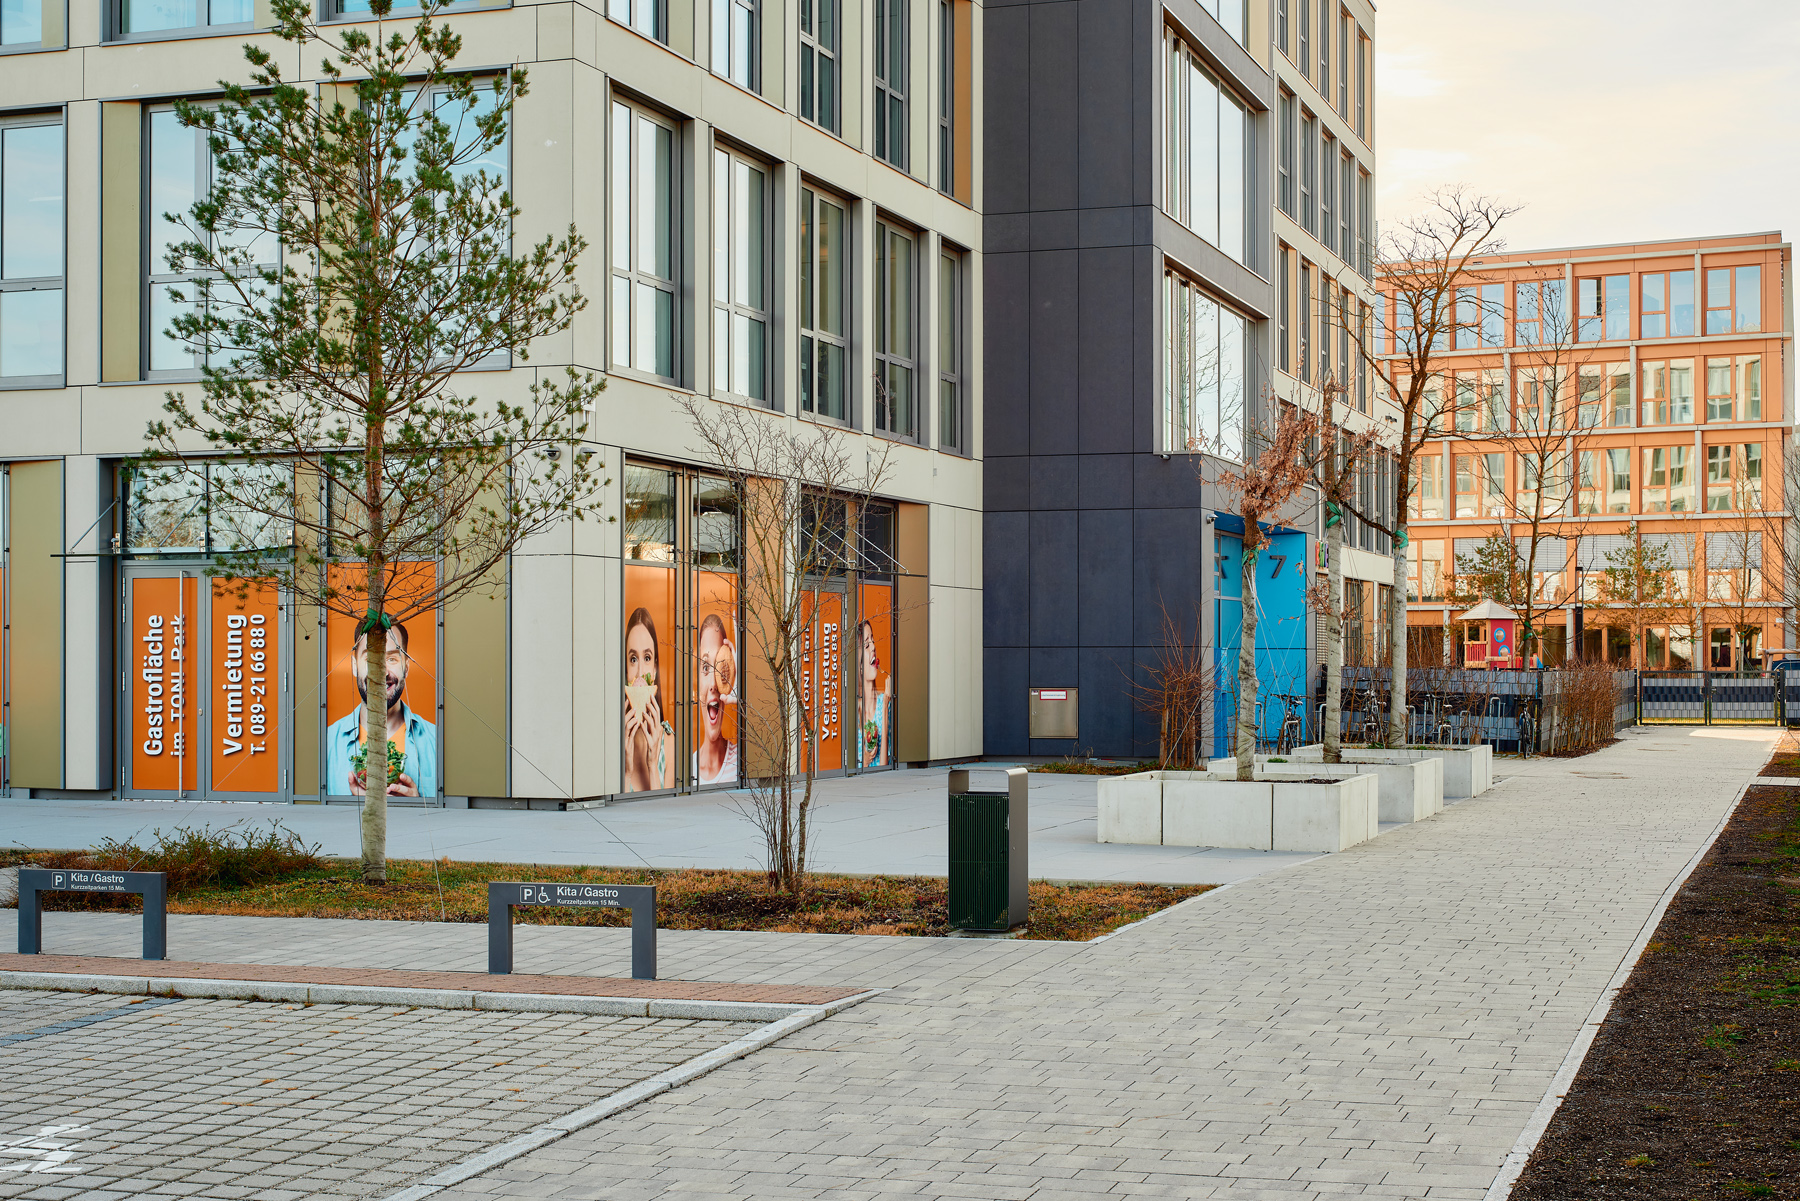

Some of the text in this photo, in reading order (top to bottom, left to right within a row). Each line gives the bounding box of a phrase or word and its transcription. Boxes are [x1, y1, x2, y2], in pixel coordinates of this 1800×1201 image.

[1270, 555, 1287, 579] 7
[143, 614, 164, 756] Gastrofläche
[170, 614, 185, 756] im TONI Park
[222, 614, 248, 756] Vermietung
[822, 623, 832, 741] Vermietung
[250, 740, 266, 755] T.
[831, 727, 838, 739] T.
[556, 898, 599, 906] Kurzzeitparken
